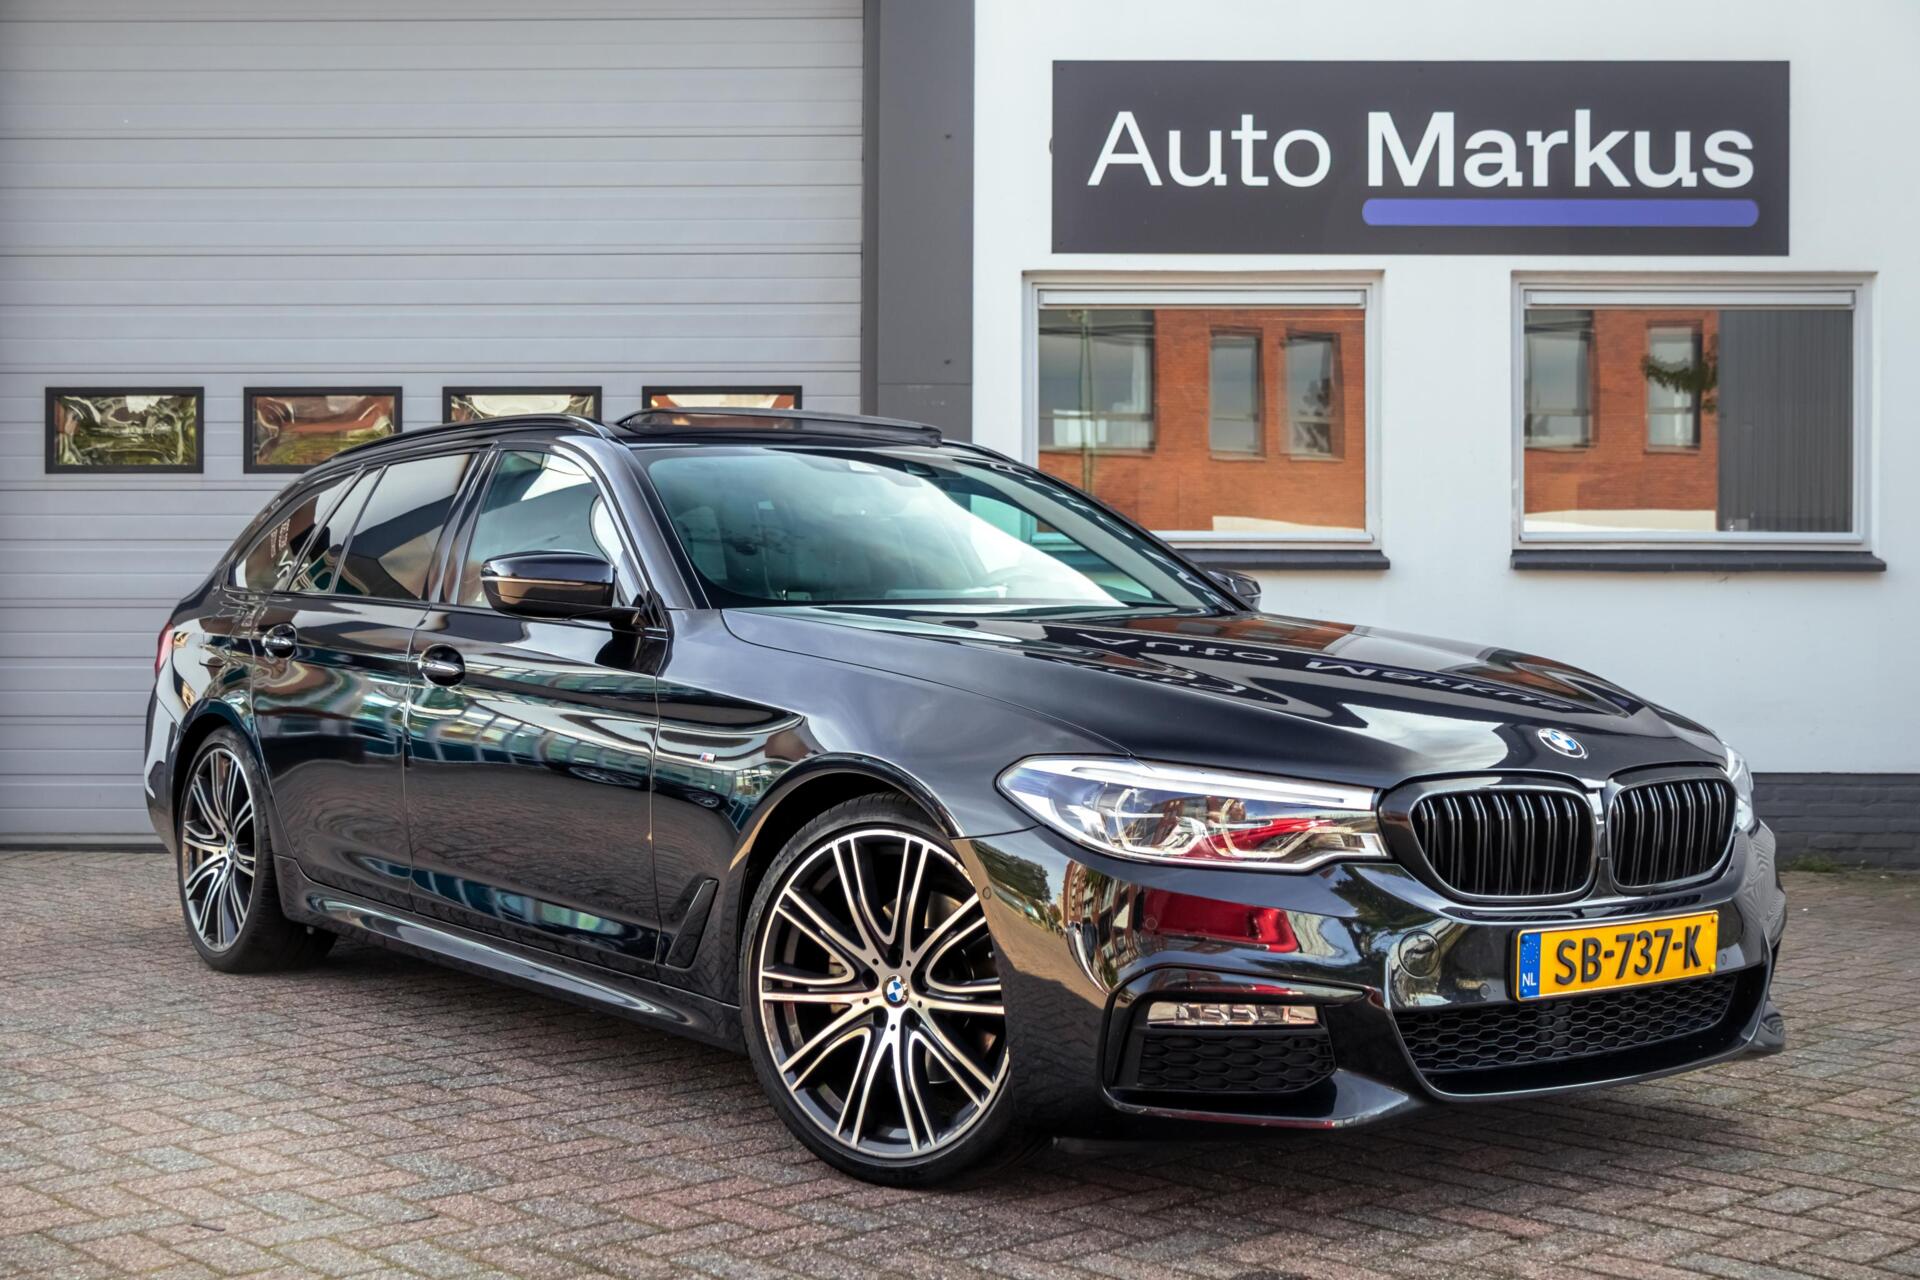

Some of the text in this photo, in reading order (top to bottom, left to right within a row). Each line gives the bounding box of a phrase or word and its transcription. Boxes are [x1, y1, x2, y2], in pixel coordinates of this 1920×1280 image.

[1087, 108, 1754, 189] Auto Markus
[1522, 972, 1537, 987] NL
[1554, 924, 1702, 986] SB-737-K
